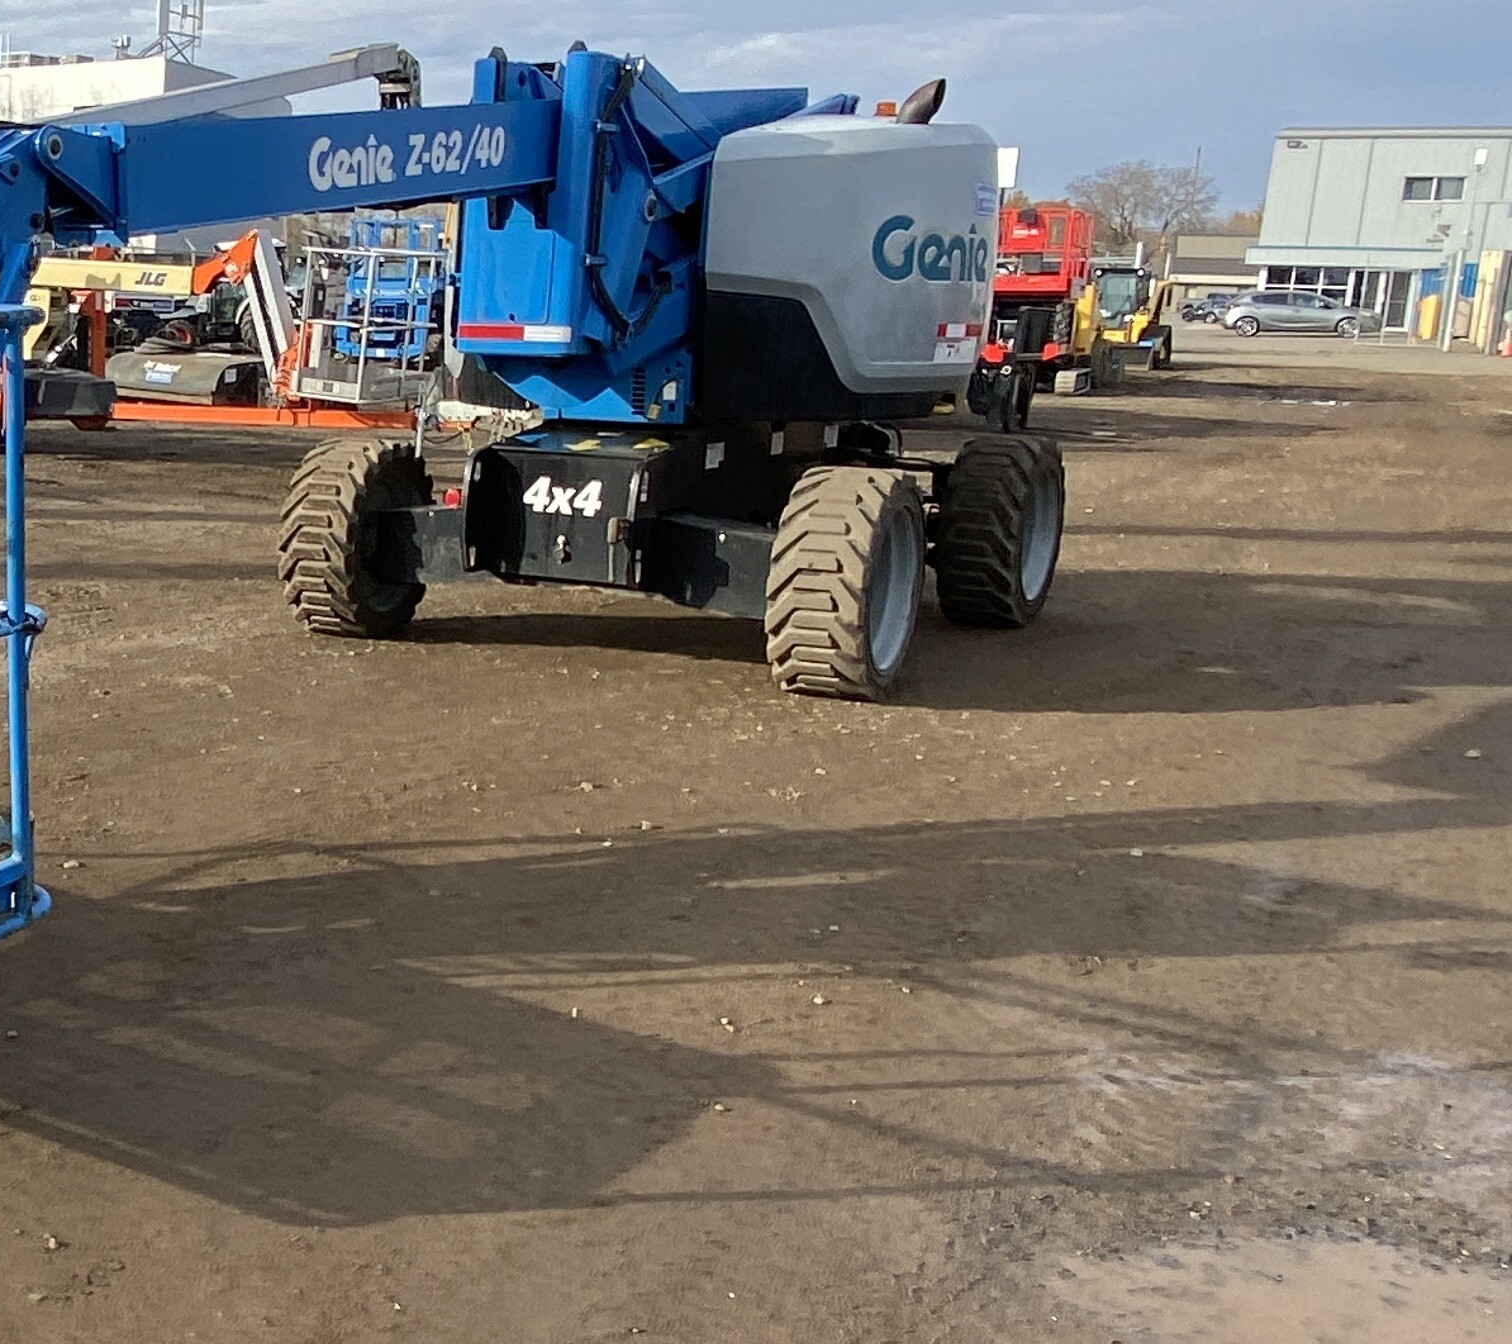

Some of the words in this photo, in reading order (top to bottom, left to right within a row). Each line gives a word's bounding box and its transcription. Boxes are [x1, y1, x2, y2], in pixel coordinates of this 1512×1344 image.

[309, 134, 396, 192] Genie
[405, 124, 505, 177] Z-62/40
[872, 214, 987, 282] Genie
[135, 272, 167, 286] JLG
[523, 475, 603, 517] 4x4
